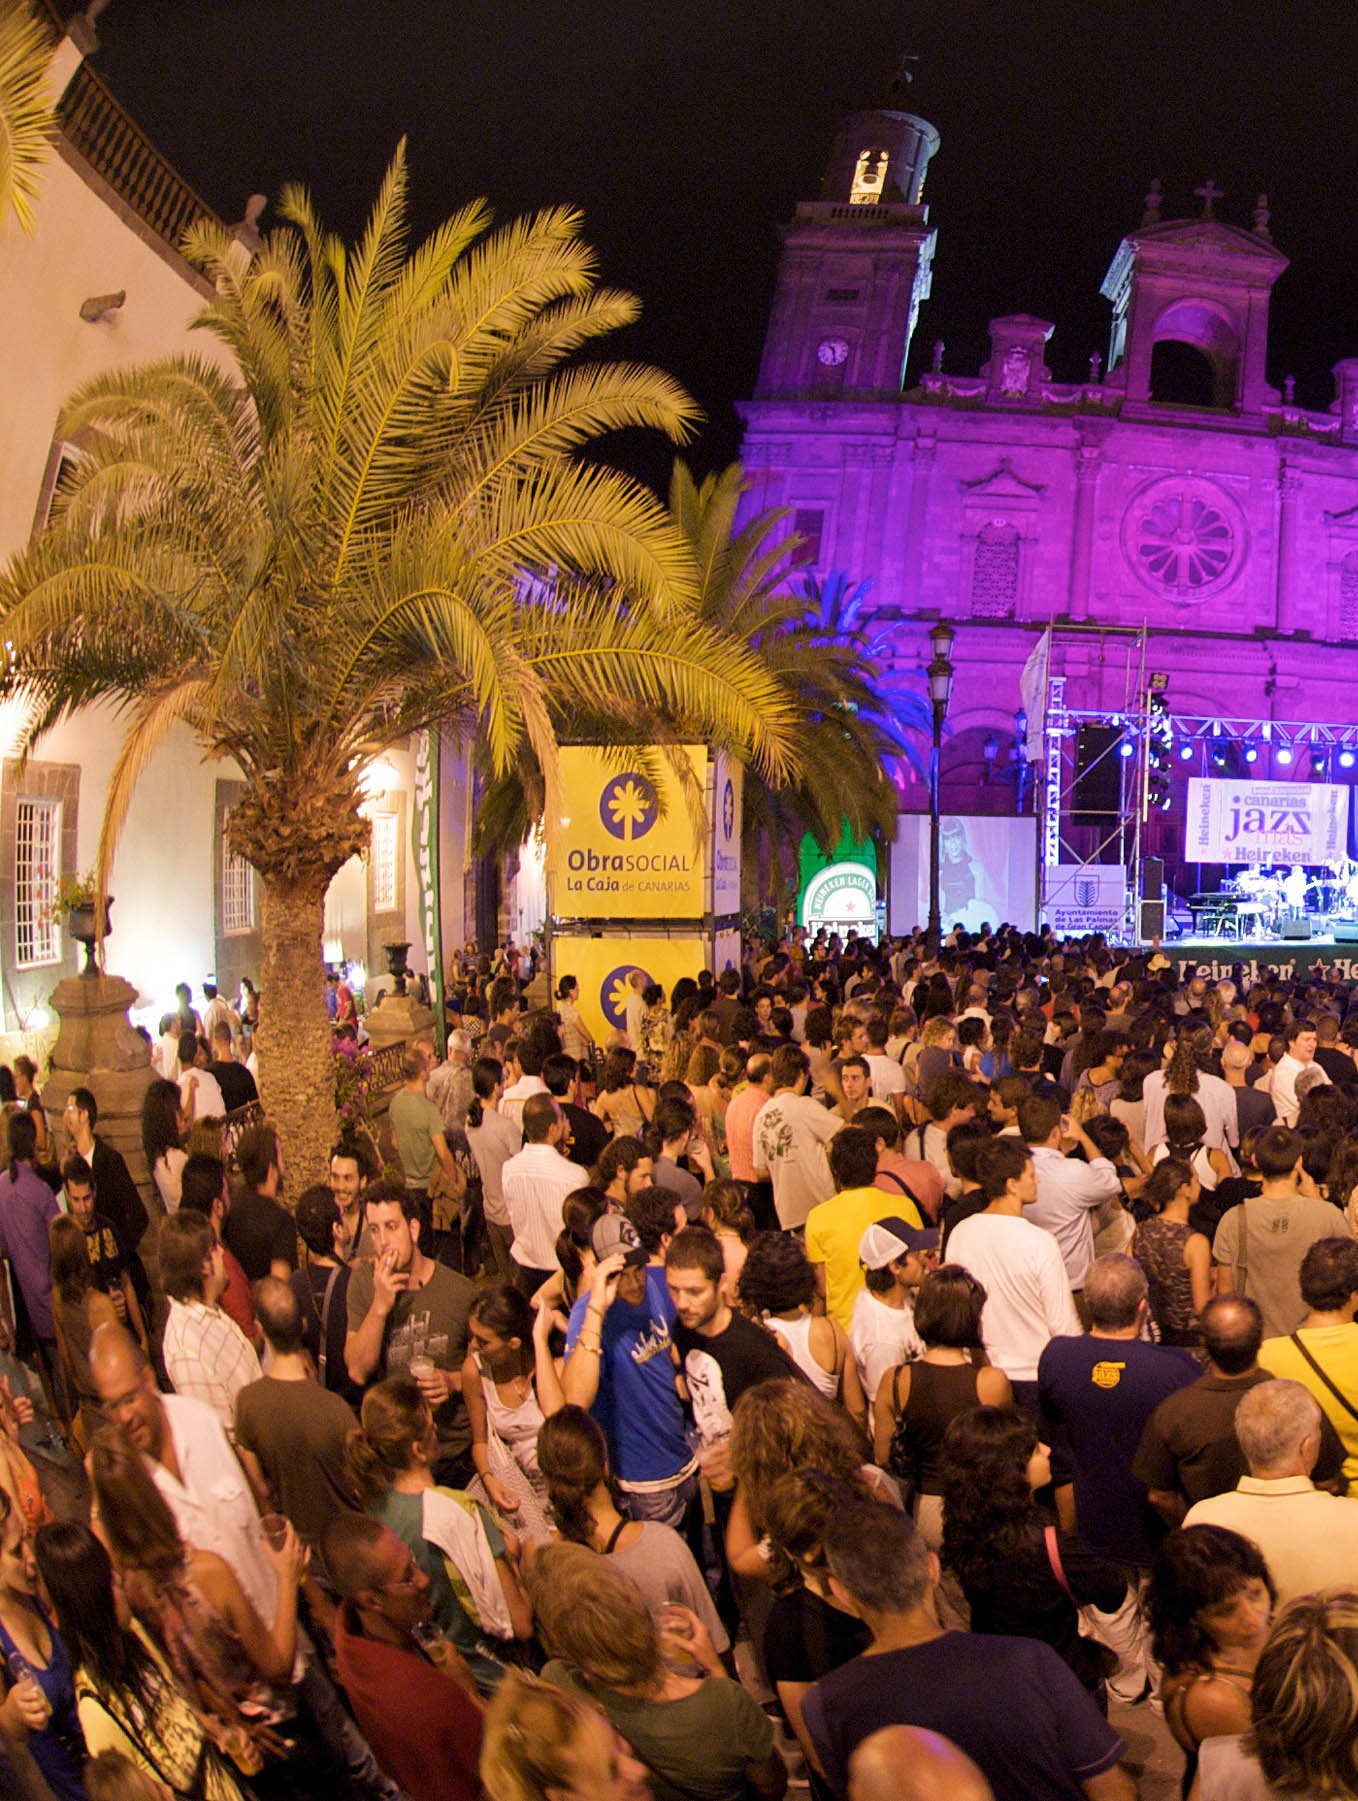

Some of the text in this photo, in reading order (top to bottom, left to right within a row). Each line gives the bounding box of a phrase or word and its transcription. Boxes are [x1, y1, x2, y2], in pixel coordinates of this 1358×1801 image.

[1198, 784, 1211, 845] Heineken
[1244, 796, 1306, 807] canarias
[1225, 795, 1311, 841] jazz
[567, 876, 691, 892] La Caja de CANARIAS
